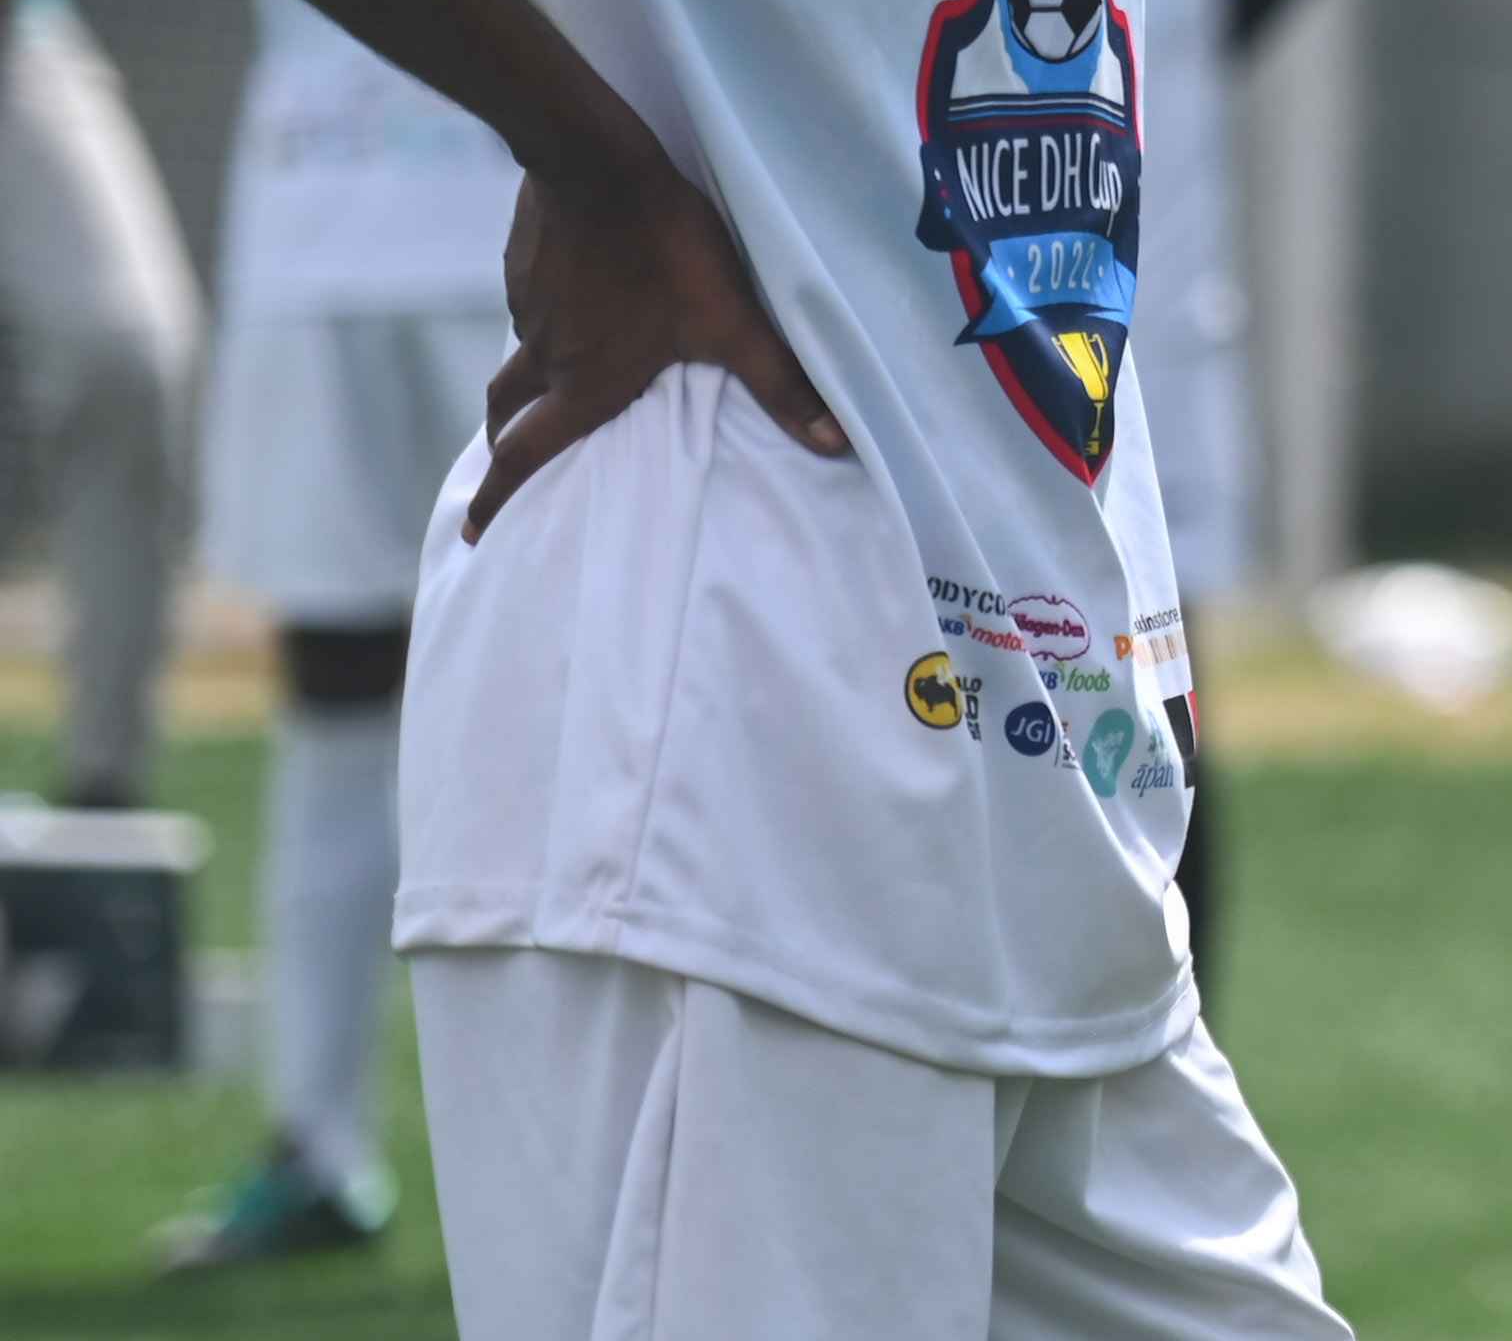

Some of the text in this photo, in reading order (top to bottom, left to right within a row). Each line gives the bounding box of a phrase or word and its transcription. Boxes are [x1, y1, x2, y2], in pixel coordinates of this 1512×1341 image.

[956, 137, 1031, 222] NICE
[1040, 132, 1083, 212] DH
[1028, 239, 1096, 294] 2022
[1066, 665, 1111, 692] foods
